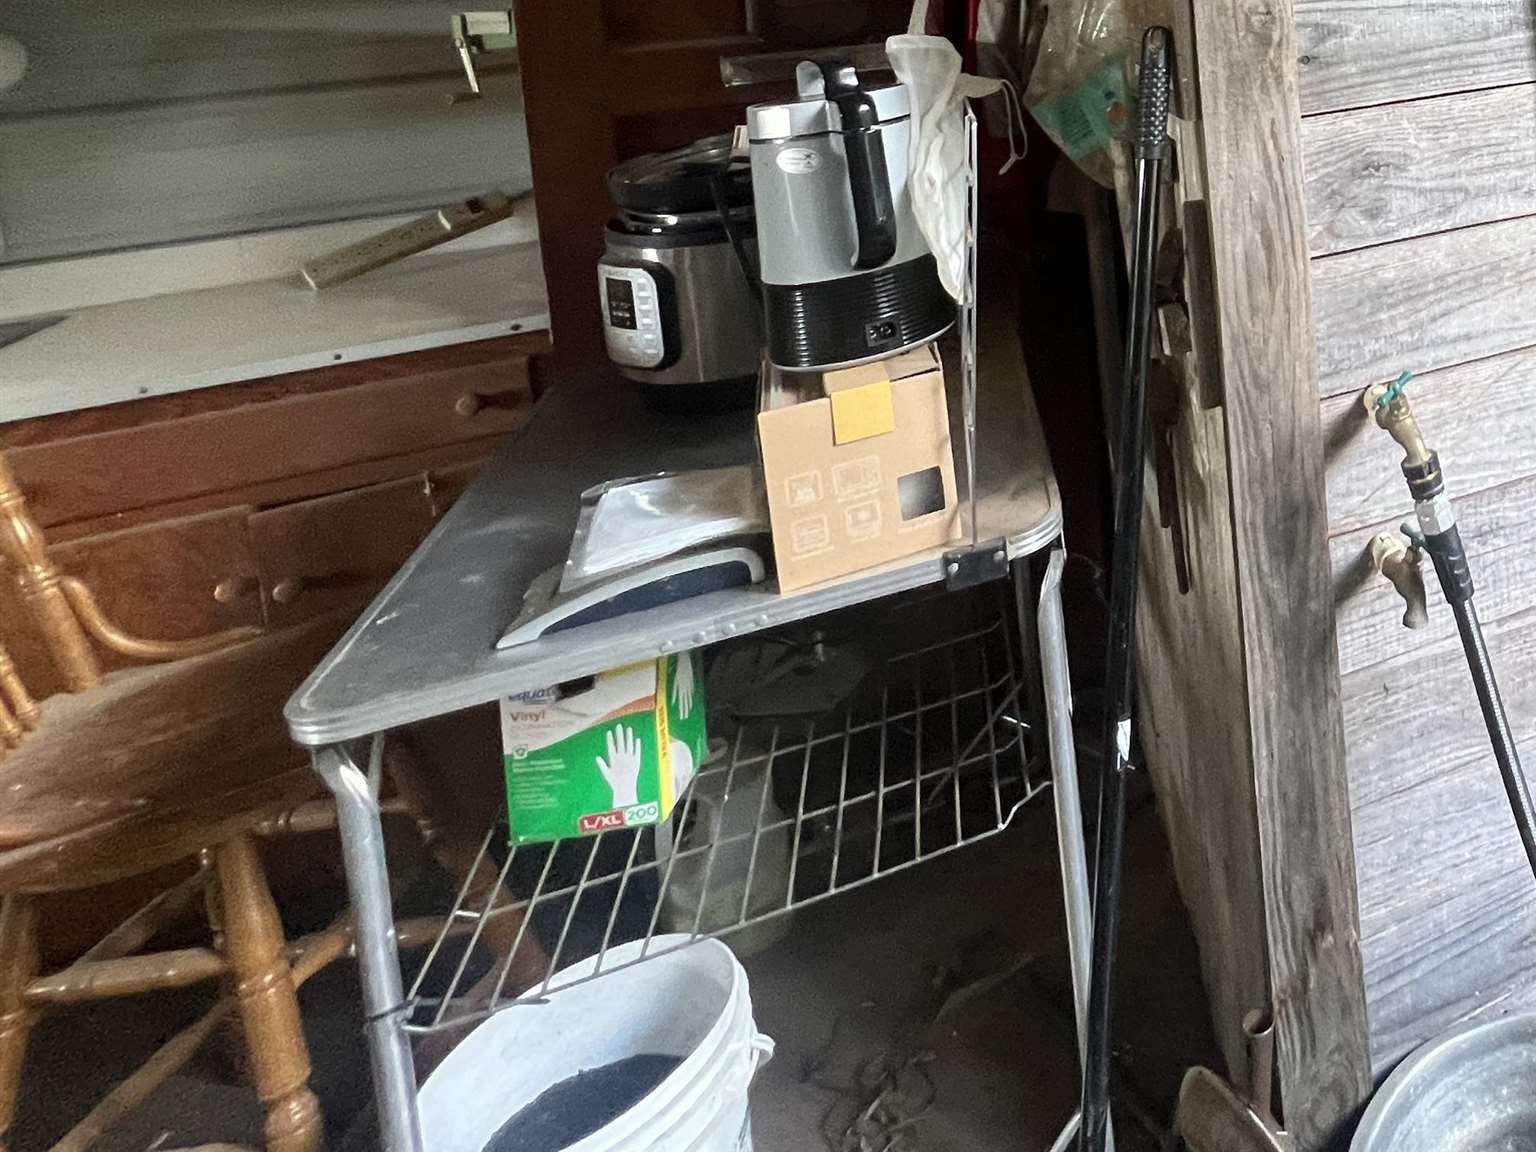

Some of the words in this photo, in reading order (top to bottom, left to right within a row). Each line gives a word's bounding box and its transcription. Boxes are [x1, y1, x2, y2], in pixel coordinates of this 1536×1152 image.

[511, 710, 546, 722] Vinyl
[583, 814, 623, 829] L/XL
[627, 805, 657, 821] 200
